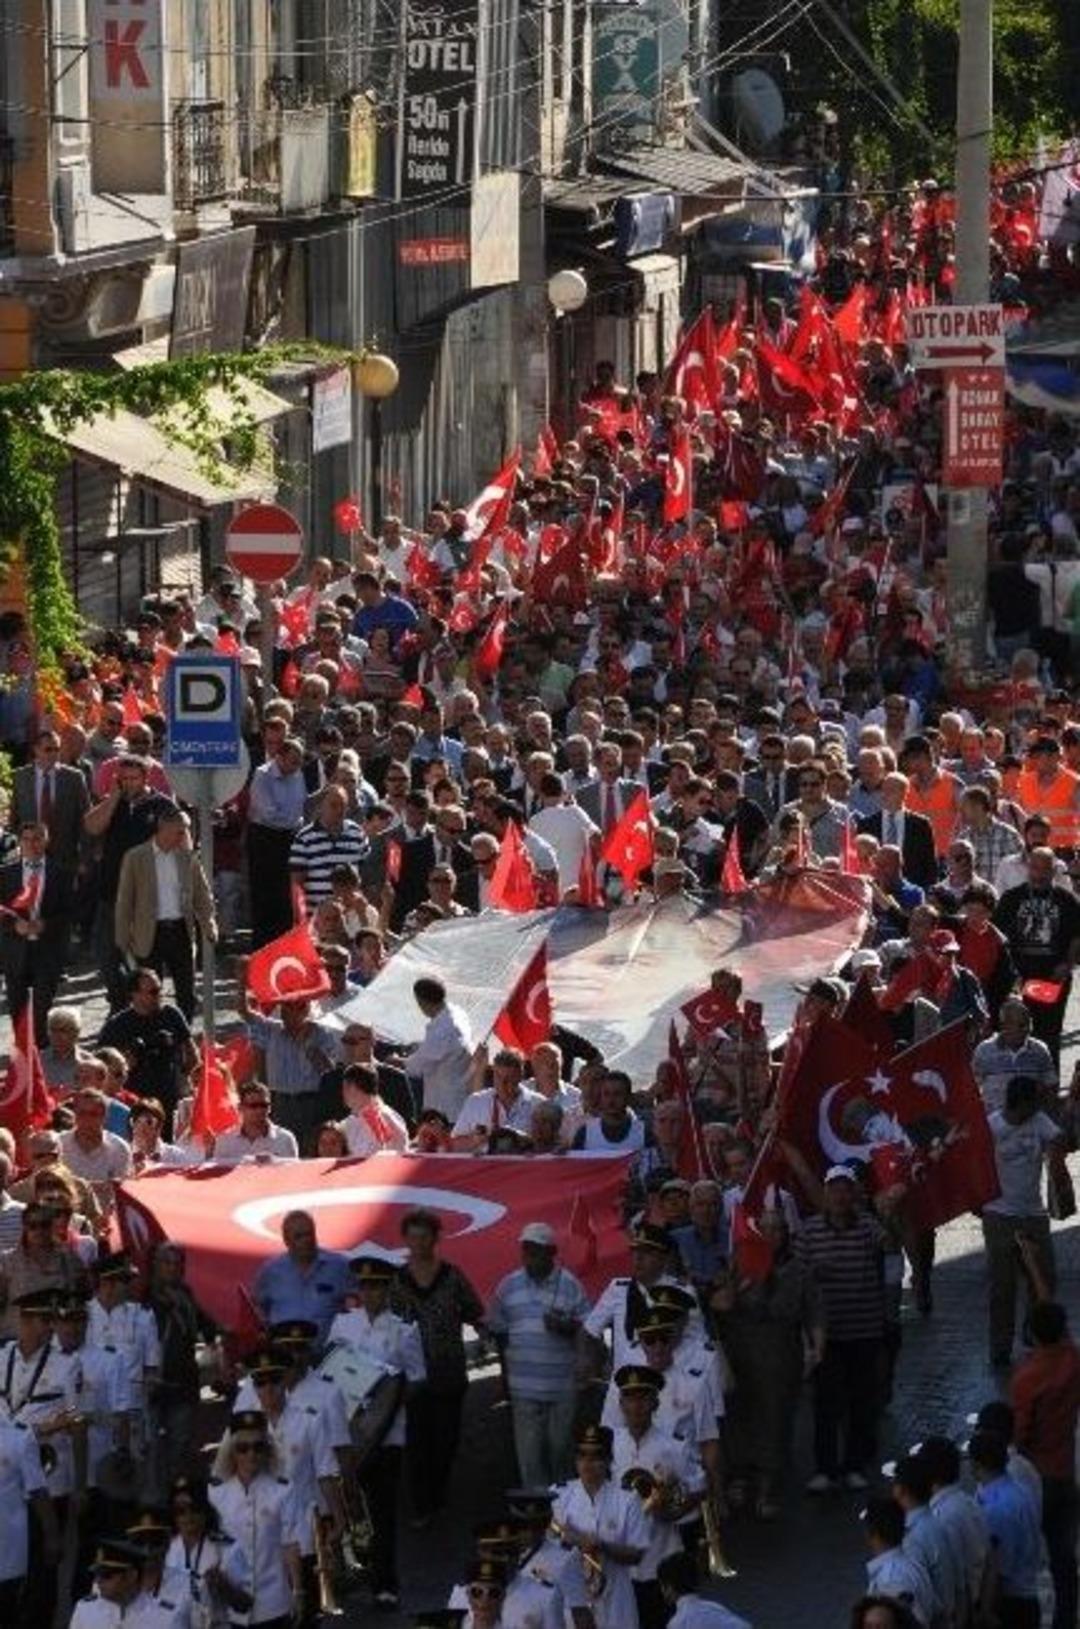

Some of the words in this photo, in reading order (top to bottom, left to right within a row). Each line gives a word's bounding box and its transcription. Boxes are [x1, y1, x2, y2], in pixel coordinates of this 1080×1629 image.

[408, 40, 475, 70] OTEL
[912, 309, 1001, 338] OTOPARK
[961, 432, 999, 450] OTEL
[181, 674, 226, 712] D
